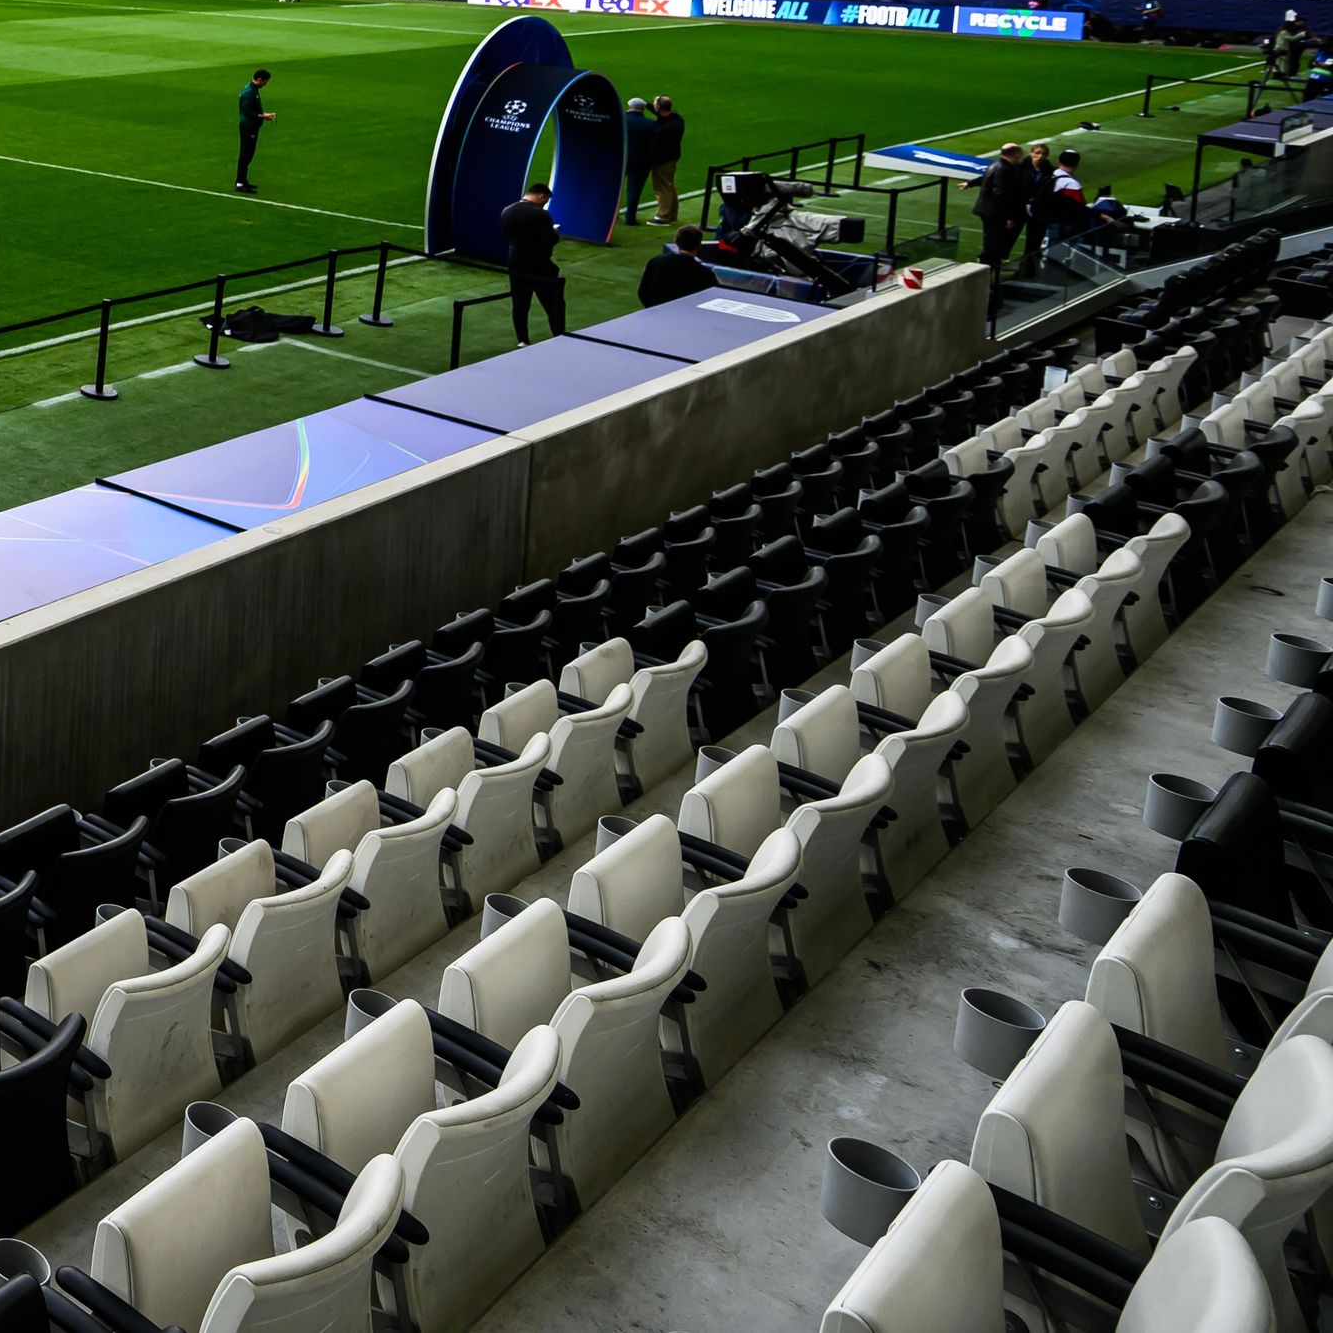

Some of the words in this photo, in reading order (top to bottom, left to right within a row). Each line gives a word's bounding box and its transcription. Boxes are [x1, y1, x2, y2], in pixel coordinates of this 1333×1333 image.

[776, 1, 808, 20] ALL
[840, 4, 940, 29] #FOOTBALL
[969, 12, 1067, 32] RECYCLE
[484, 116, 531, 129] CHAMPIONS
[490, 122, 520, 132] LEAGUE
